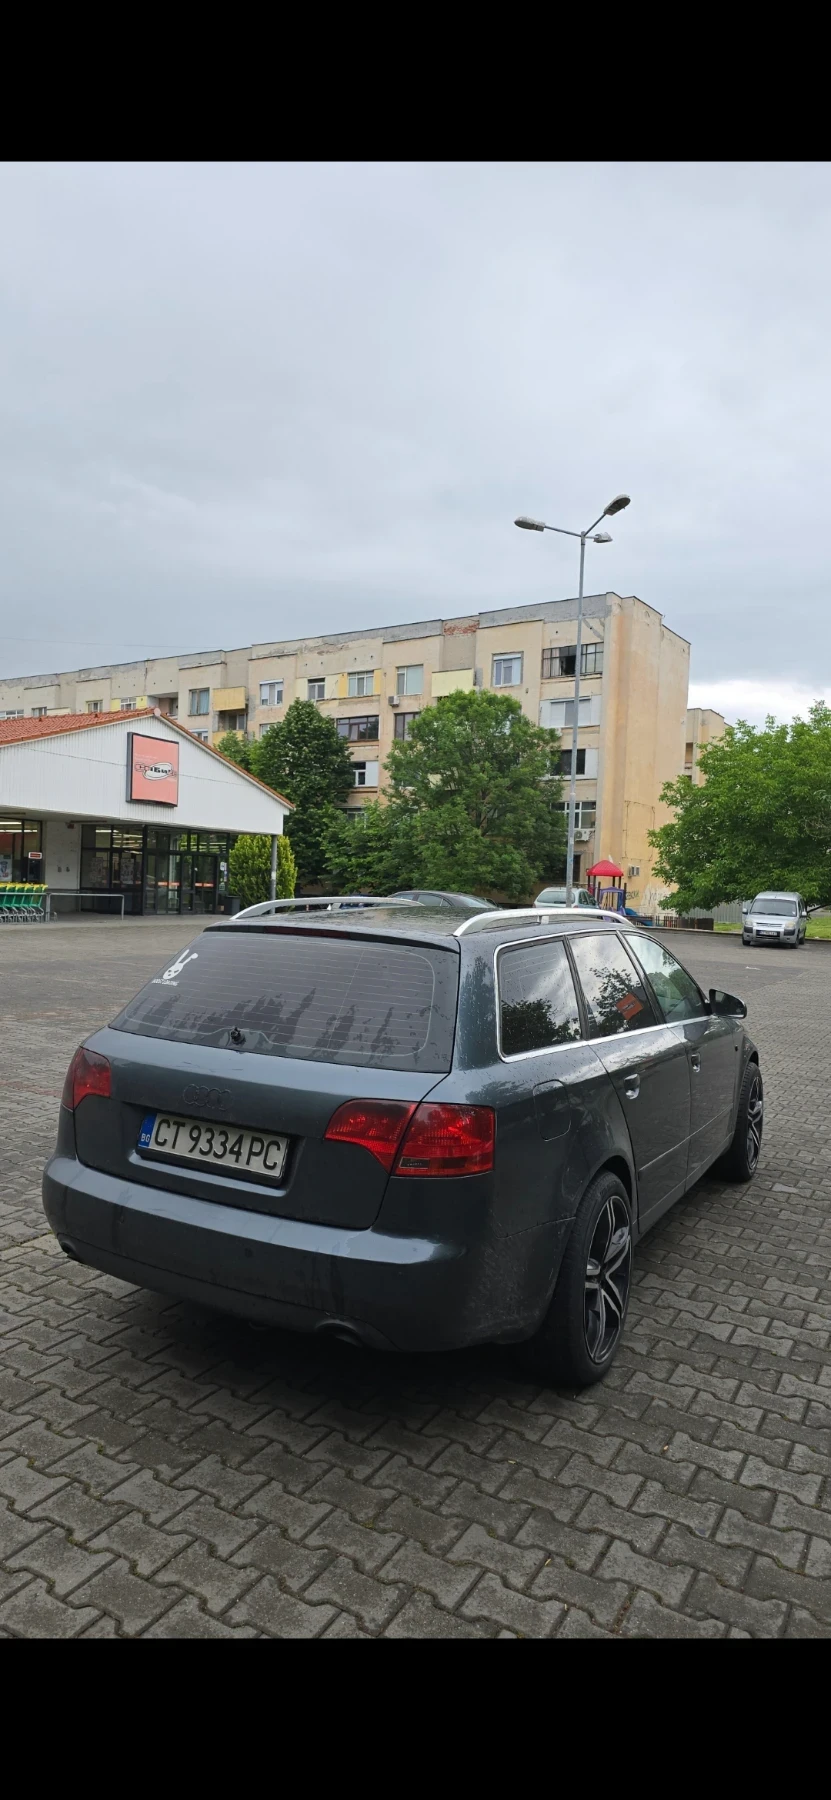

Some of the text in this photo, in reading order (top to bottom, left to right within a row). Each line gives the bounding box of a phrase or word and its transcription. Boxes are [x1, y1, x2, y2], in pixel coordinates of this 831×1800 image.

[141, 1133, 150, 1143] BG
[154, 1119, 281, 1171] CT 9334 PC
